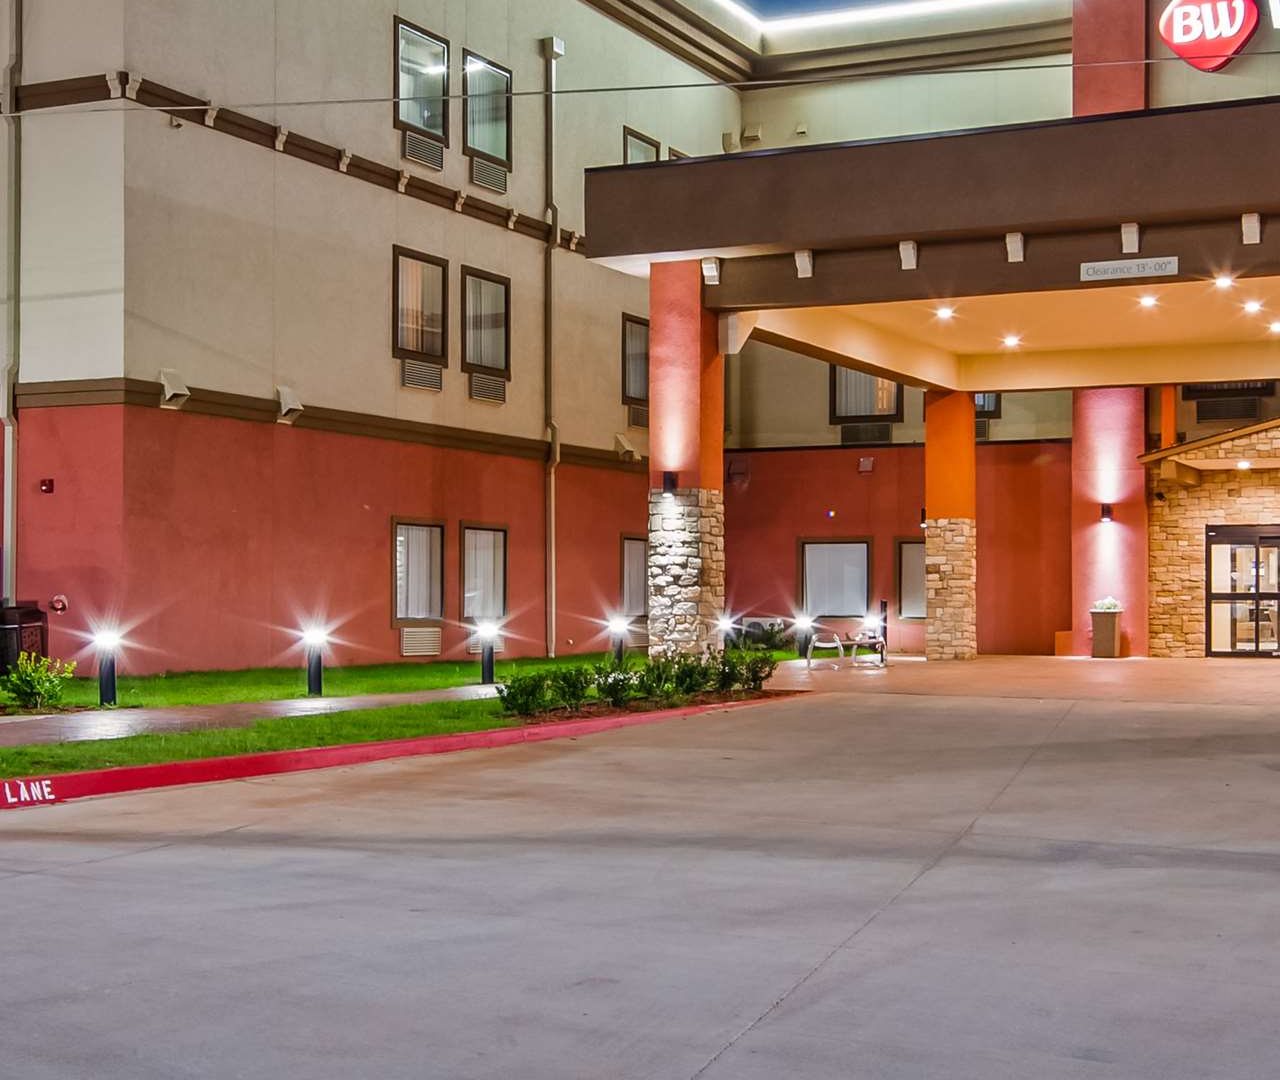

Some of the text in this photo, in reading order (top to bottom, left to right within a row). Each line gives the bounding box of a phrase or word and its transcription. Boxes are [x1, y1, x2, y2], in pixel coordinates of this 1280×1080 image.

[1173, 0, 1245, 44] BW
[1086, 266, 1133, 277] Clearance
[4, 780, 55, 804] LANE
